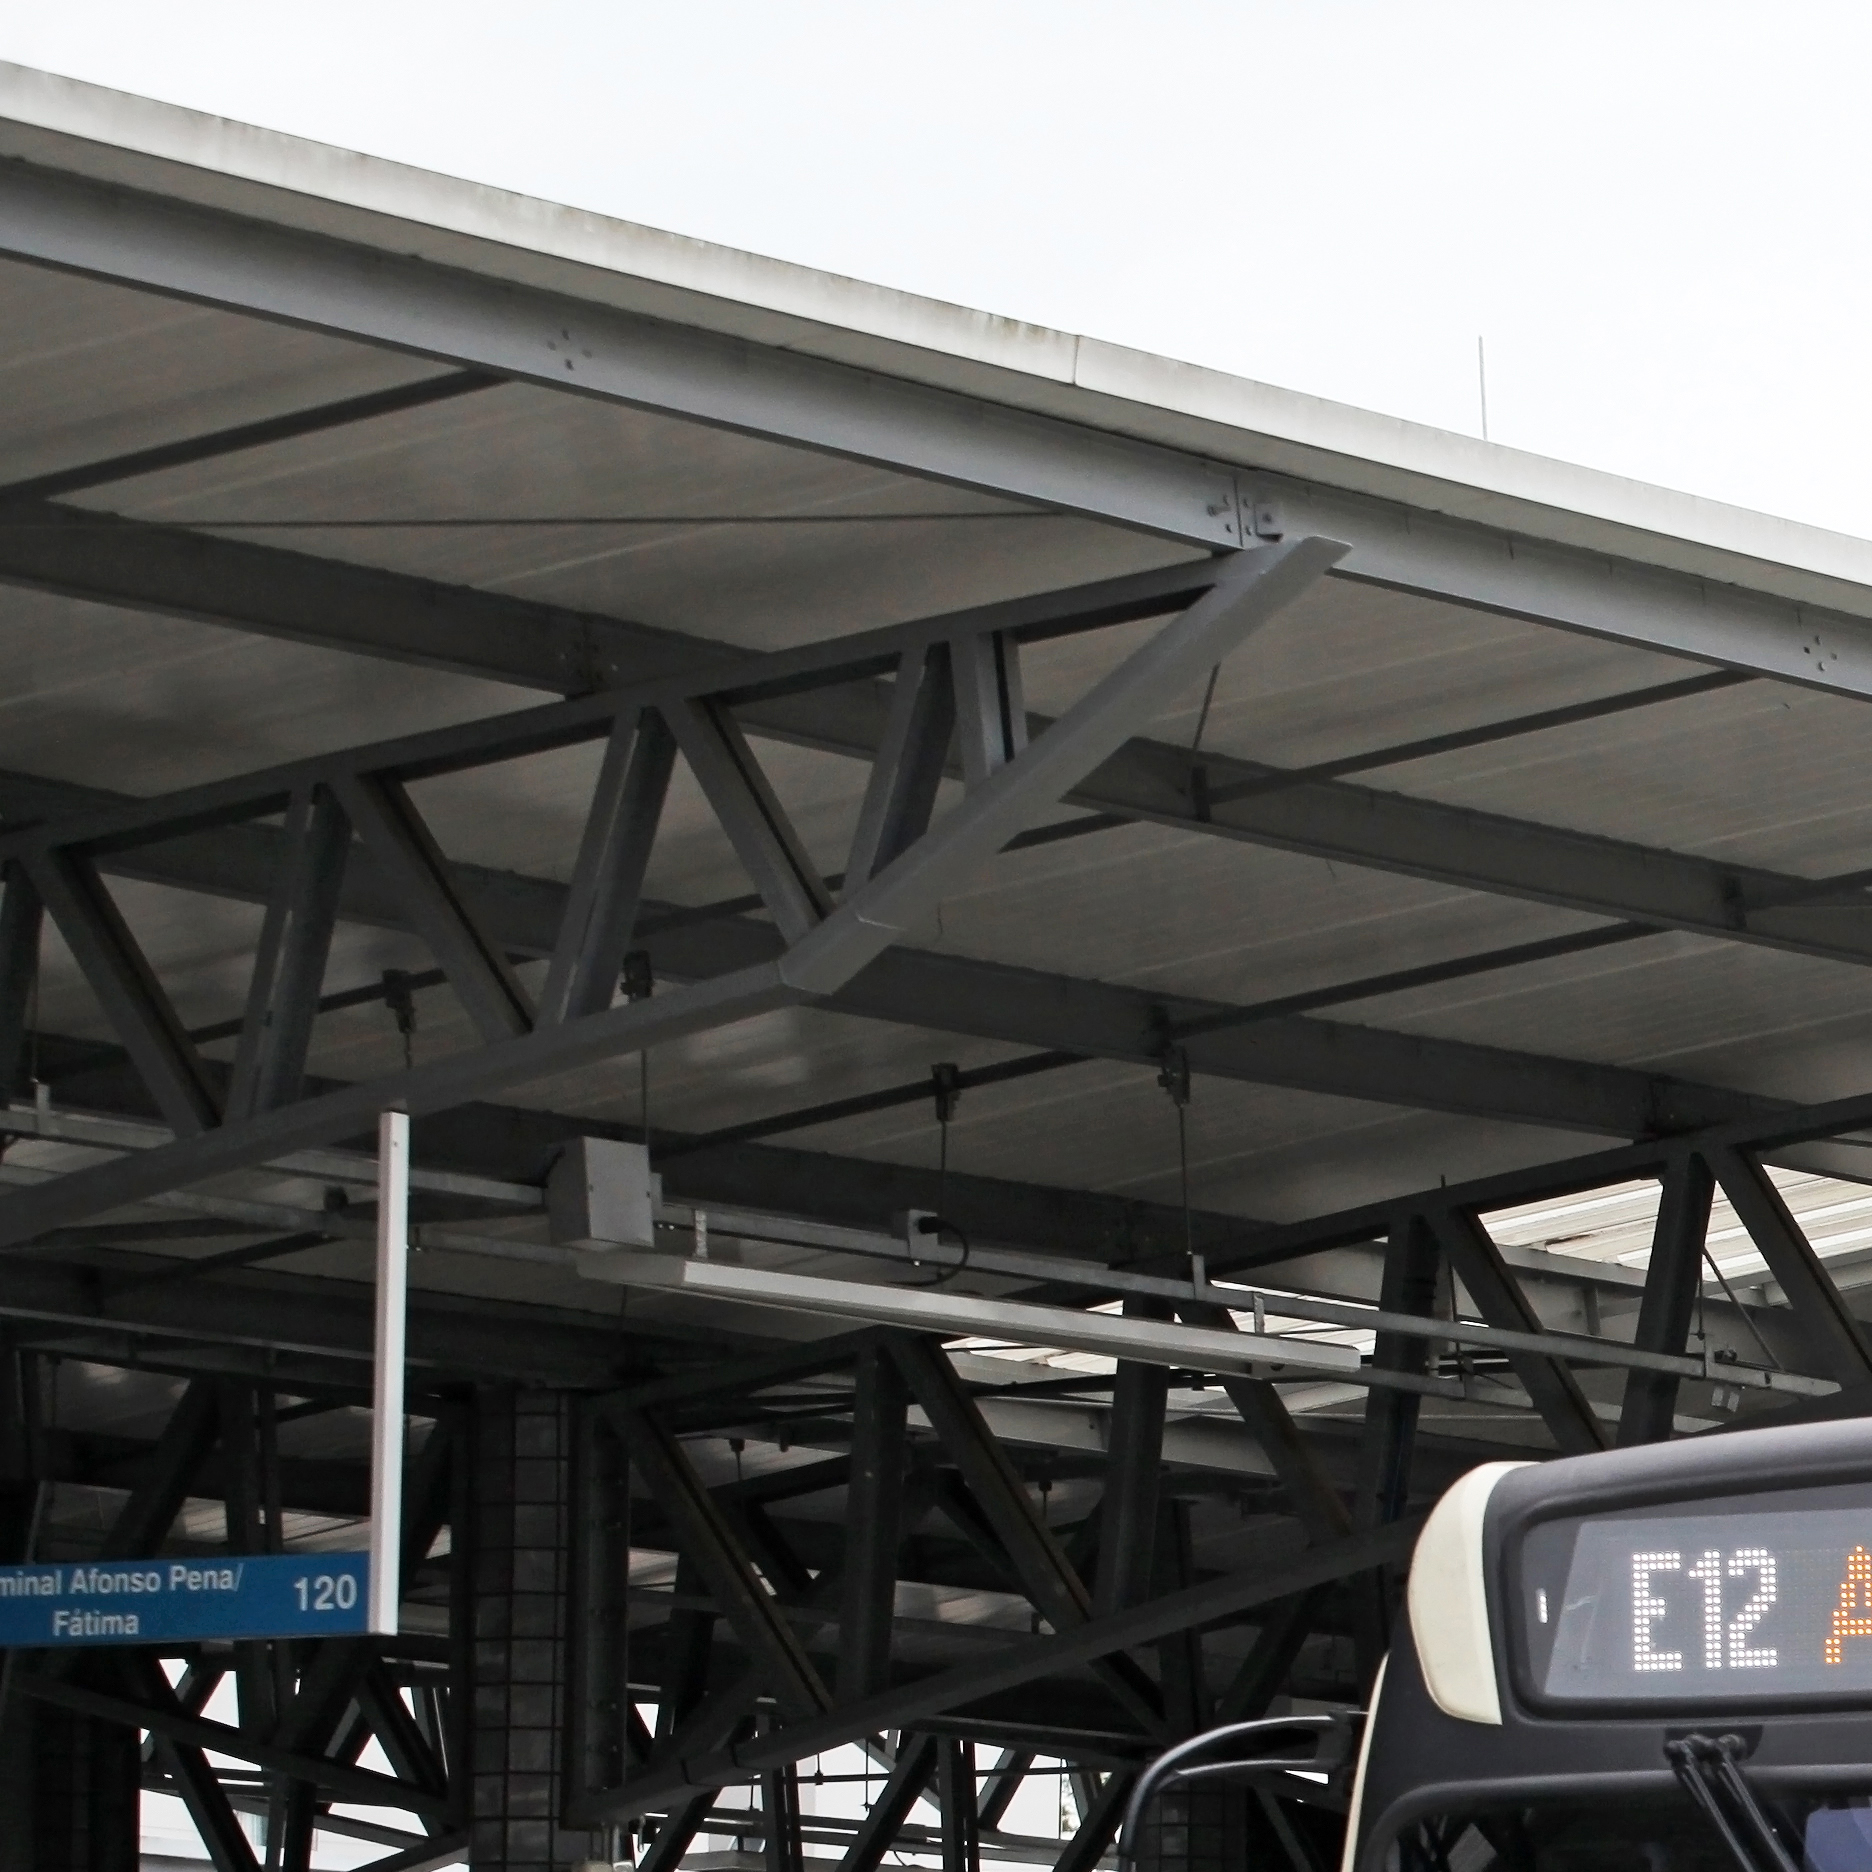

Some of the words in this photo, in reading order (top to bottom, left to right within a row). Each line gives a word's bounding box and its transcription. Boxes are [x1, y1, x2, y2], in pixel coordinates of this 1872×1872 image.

[69, 1568, 162, 1595] Afonso
[169, 1563, 244, 1592] Pena/
[294, 1574, 358, 1611] 120
[52, 1609, 139, 1637] Fátima
[1632, 1547, 1779, 1673] E12
